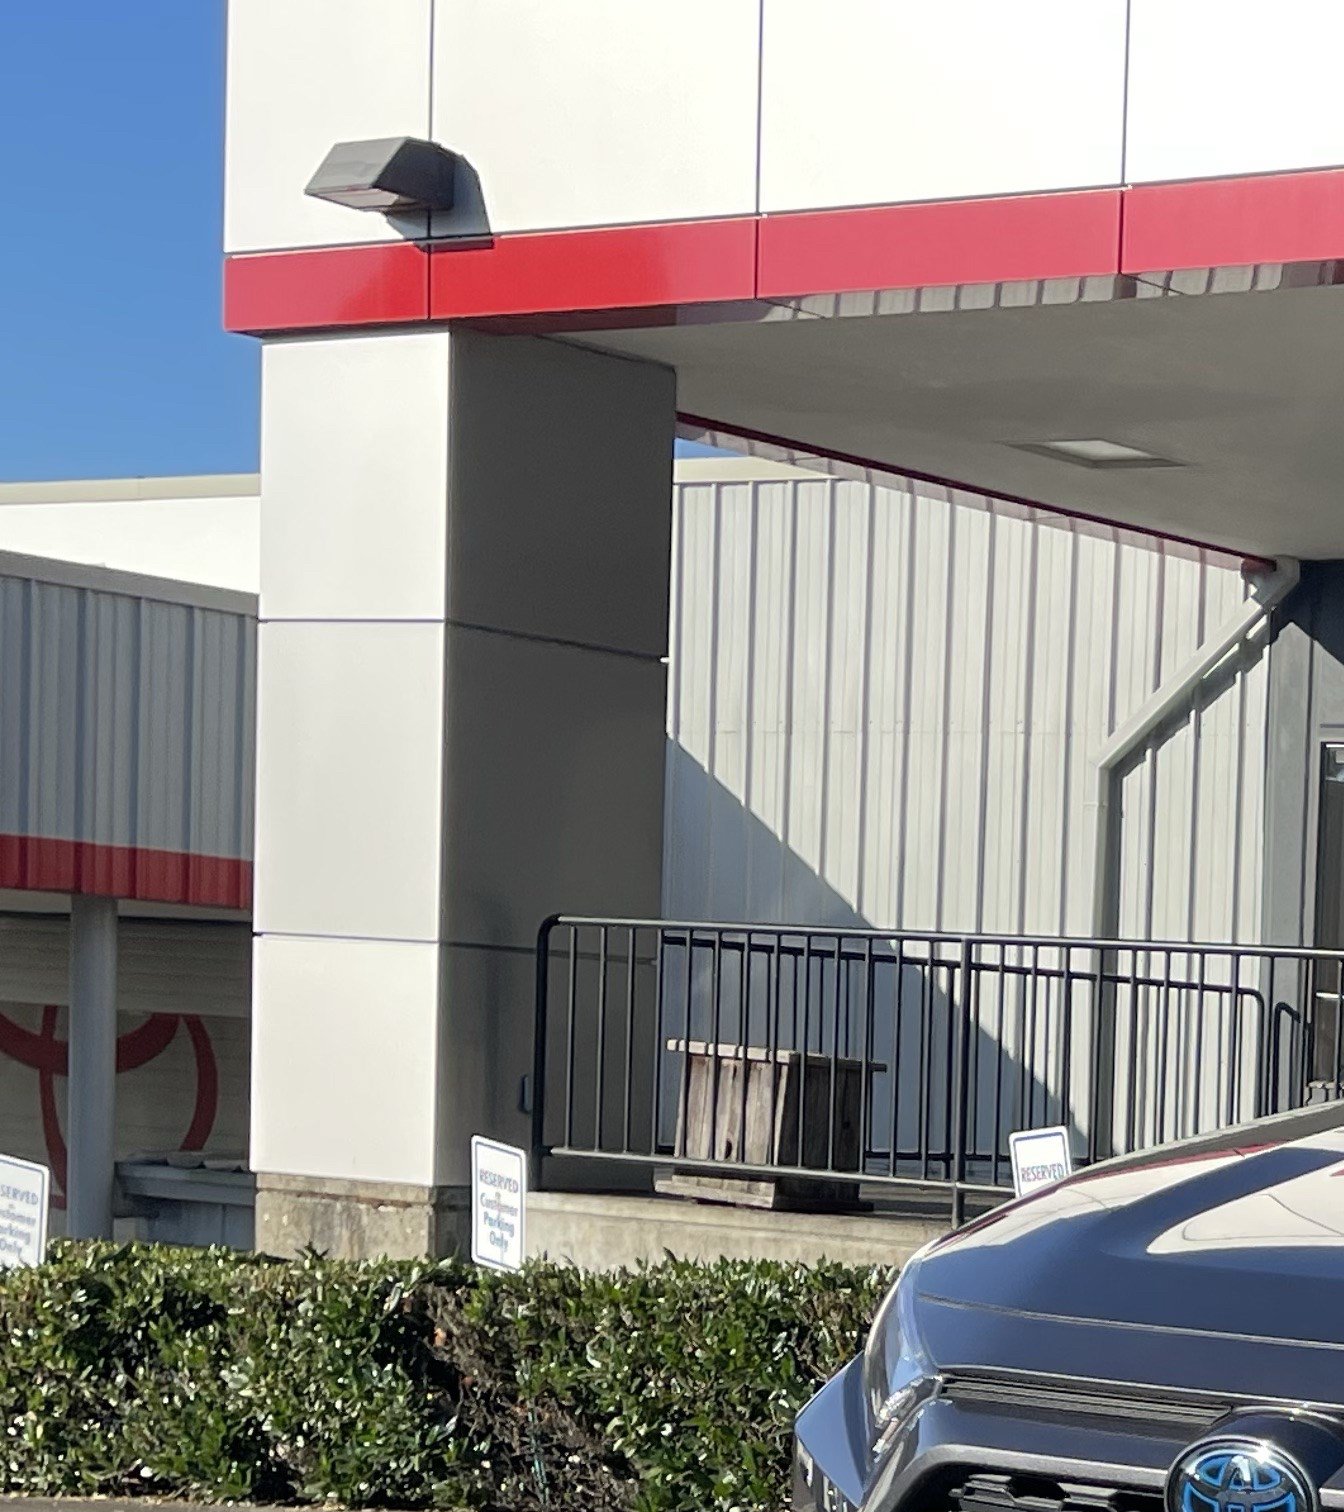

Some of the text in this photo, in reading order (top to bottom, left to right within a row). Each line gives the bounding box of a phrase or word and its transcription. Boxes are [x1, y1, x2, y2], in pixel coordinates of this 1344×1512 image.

[479, 1169, 519, 1194] RESERVED
[1020, 1162, 1065, 1182] RESERVED
[0, 1184, 39, 1205] SERVED
[480, 1192, 519, 1217] Customer
[483, 1211, 515, 1239] Parking
[489, 1230, 509, 1253] Only
